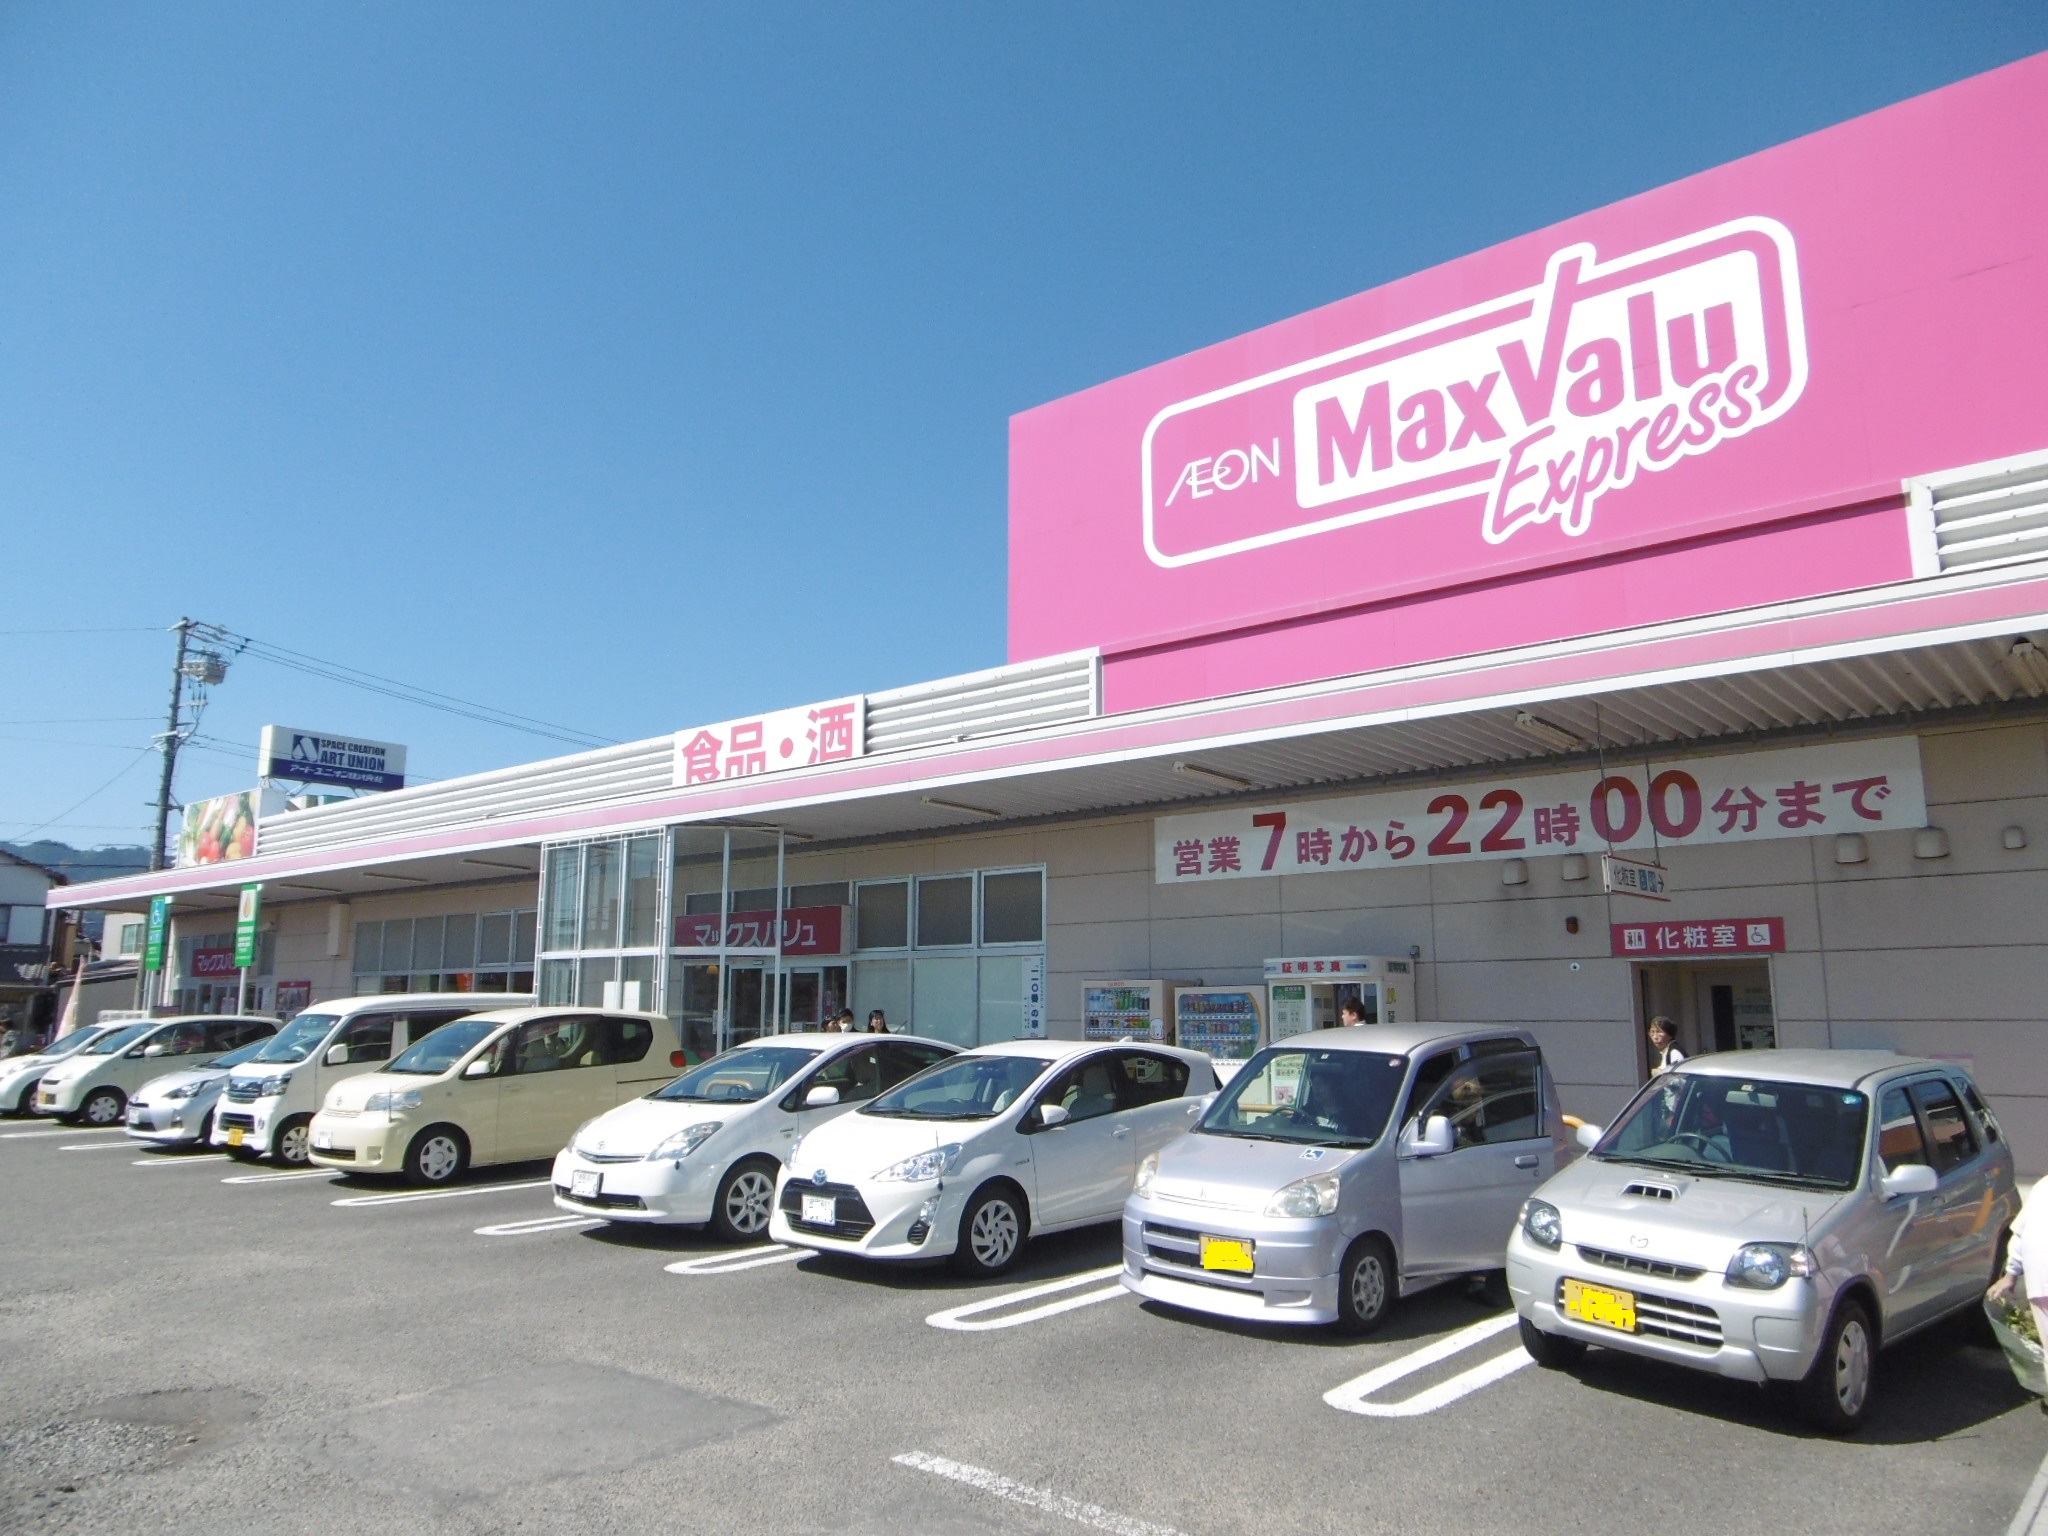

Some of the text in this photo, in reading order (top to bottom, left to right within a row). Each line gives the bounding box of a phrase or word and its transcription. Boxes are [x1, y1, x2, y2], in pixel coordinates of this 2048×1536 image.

[1314, 254, 1739, 487] MaxValu
[1496, 363, 1761, 528] Express
[320, 739, 386, 756] SPACE CREATION
[319, 751, 386, 771] ART UNION
[1614, 864, 1637, 887] 化粧室
[694, 918, 816, 947] マックスバリュ
[1655, 924, 1737, 949] 化粧室
[1281, 960, 1341, 973] 証明写真
